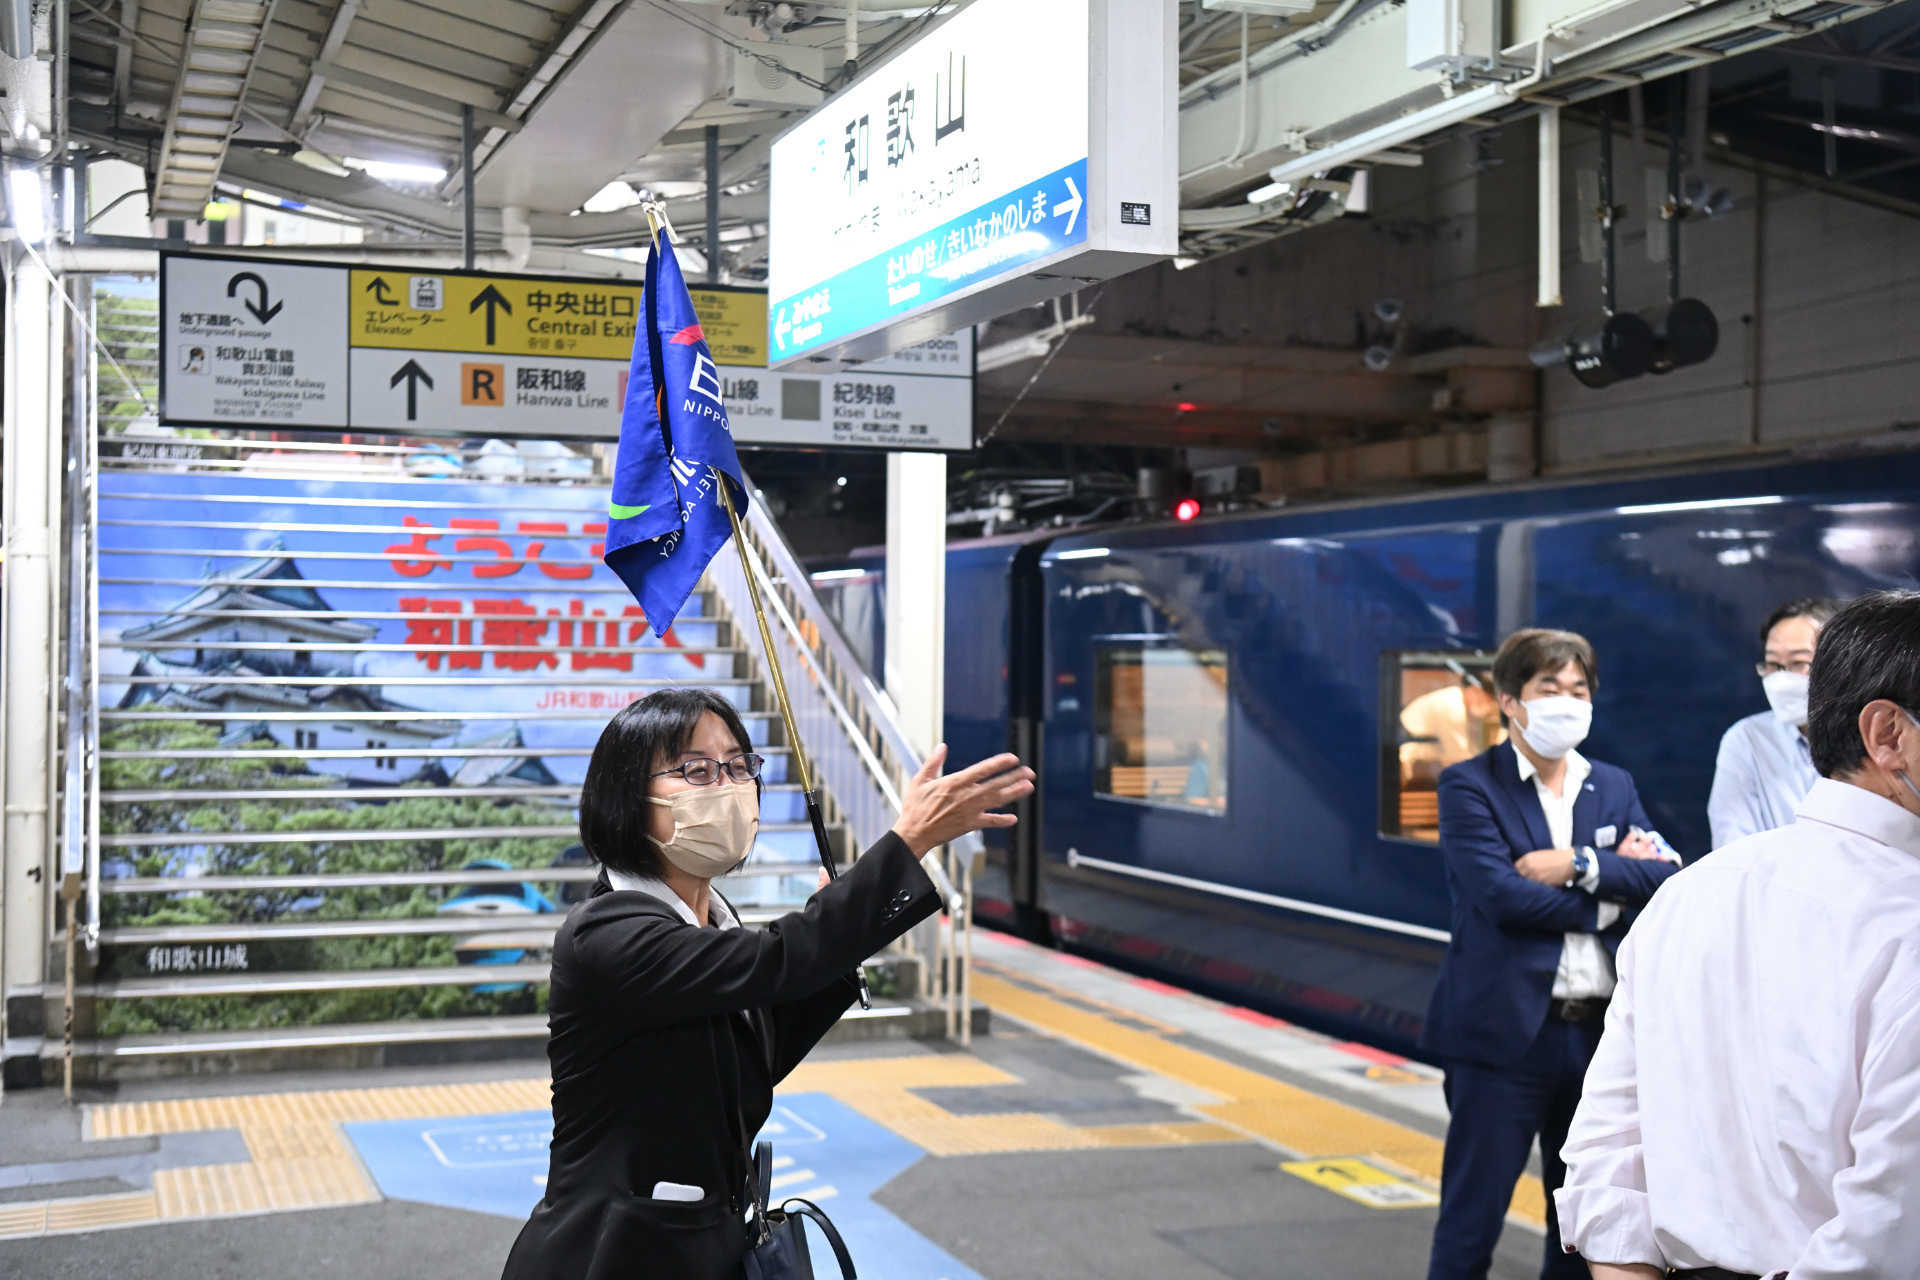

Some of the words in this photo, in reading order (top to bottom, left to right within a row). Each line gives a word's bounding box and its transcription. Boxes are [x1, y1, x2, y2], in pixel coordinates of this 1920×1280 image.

[843, 51, 966, 196] 和歌山
[527, 290, 634, 317] 中央出口
[180, 312, 245, 327] 地下通路へ
[365, 311, 445, 326] エレベーター
[527, 317, 597, 336] Central
[603, 321, 637, 338] Exit
[179, 326, 236, 337] Underground
[238, 329, 272, 340] passage
[365, 324, 413, 335] Elevator
[472, 370, 496, 401] R
[517, 367, 586, 391] 阪和線
[302, 391, 326, 401] Line
[517, 393, 573, 407] Hanwa
[577, 395, 609, 408] Line
[833, 383, 895, 405] 紀勢線
[683, 399, 730, 430] NIPPO
[747, 404, 774, 416] Line
[834, 406, 865, 419] Kisei
[874, 408, 902, 420] Line
[383, 515, 608, 579] ようこ
[146, 944, 249, 973] 和歌山城
